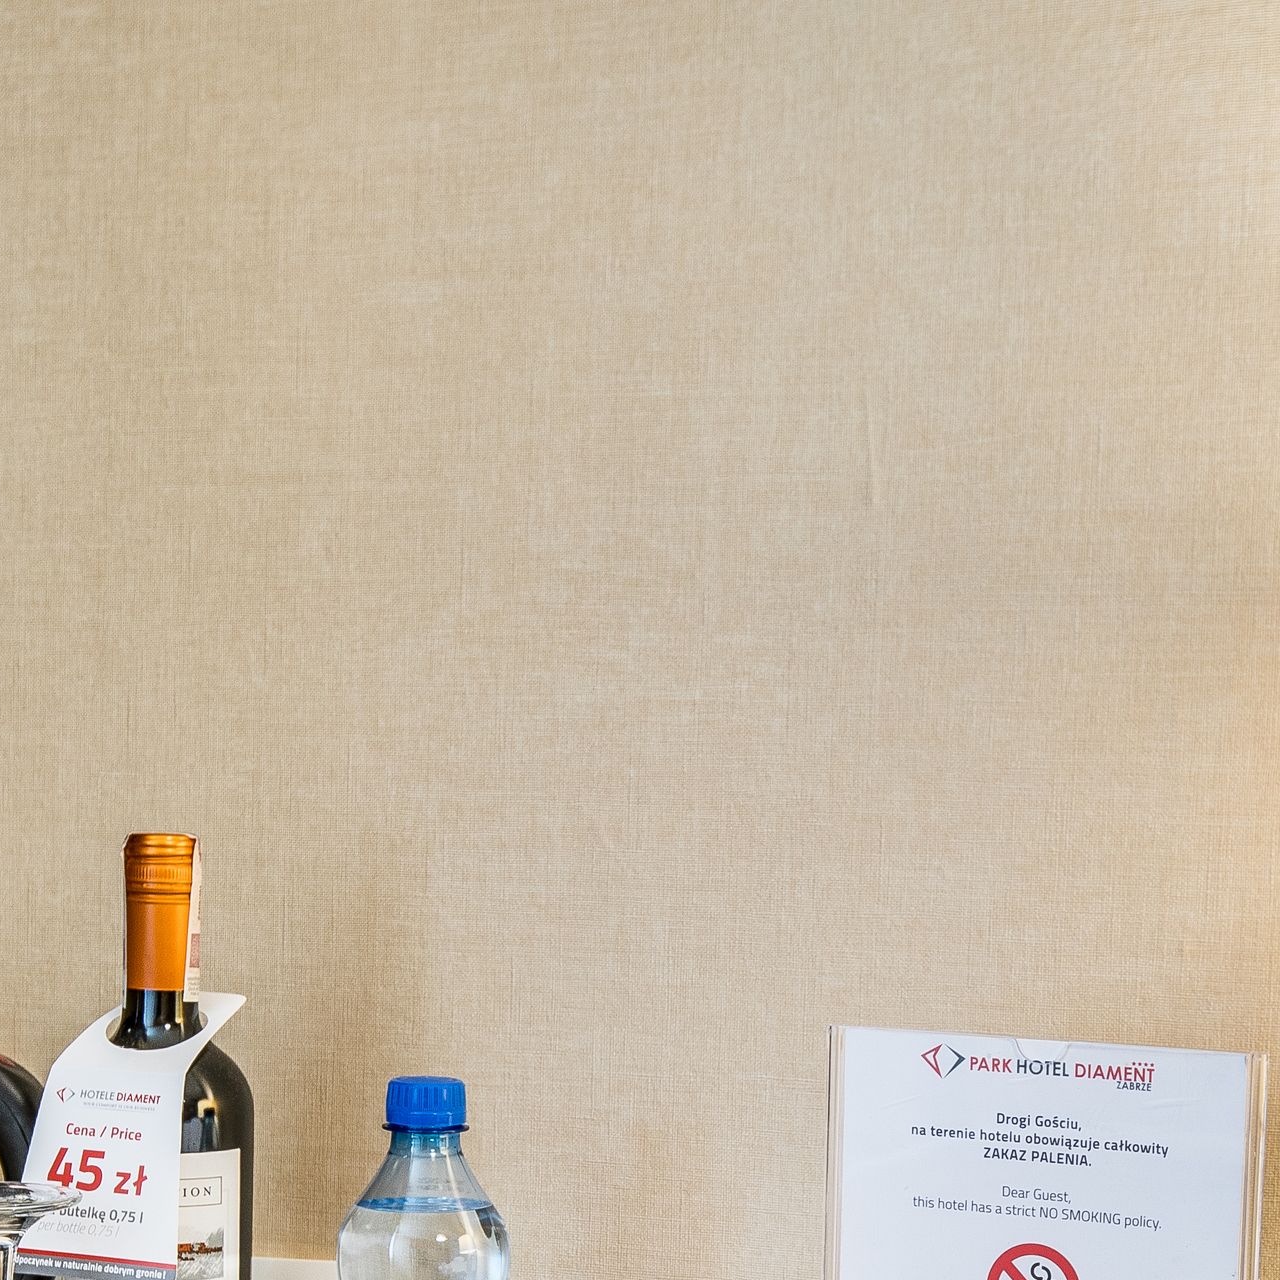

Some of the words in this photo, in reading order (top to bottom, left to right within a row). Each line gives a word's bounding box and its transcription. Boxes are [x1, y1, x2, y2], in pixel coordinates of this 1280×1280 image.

[970, 1056, 1013, 1073] PARK
[1016, 1059, 1069, 1077] HOTEL
[1074, 1063, 1155, 1083] DIAMENT
[1116, 1081, 1152, 1092] ZABRZE
[80, 1089, 115, 1101] HOTELE
[116, 1092, 161, 1105] DIAMENT
[996, 1112, 1031, 1129] Drogi
[1035, 1115, 1082, 1131] Gościu,
[66, 1122, 96, 1137] Cena
[111, 1127, 142, 1141] Price
[911, 1126, 926, 1136] na
[930, 1126, 976, 1140] terenie
[979, 1129, 1021, 1144] hotelu
[1025, 1133, 1100, 1150] obowiązuje
[1103, 1139, 1169, 1158] całkowity
[983, 1147, 1027, 1161] ZAKAZ
[1031, 1150, 1092, 1167] PALENIA.
[47, 1147, 106, 1192] 45
[113, 1165, 148, 1196] zł
[1002, 1185, 1030, 1199] Dear
[1033, 1188, 1071, 1204] Guest,
[109, 1209, 136, 1223] 0,75
[913, 1196, 935, 1209] this
[938, 1197, 968, 1211] hotel
[971, 1200, 992, 1214] has
[995, 1205, 1002, 1215] a
[1005, 1204, 1036, 1218] strict
[1039, 1206, 1058, 1219] NO
[1061, 1208, 1121, 1225] SMOKING
[1124, 1216, 1162, 1231] policy.
[38, 1221, 53, 1234] per
[56, 1222, 86, 1234] bottle
[88, 1224, 113, 1238] 0,75
[14, 1254, 54, 1268] dpoczynek
[54, 1260, 62, 1268] w
[63, 1260, 102, 1273] naturalnie
[104, 1263, 134, 1277] dobrym
[136, 1269, 166, 1280] gronie!
